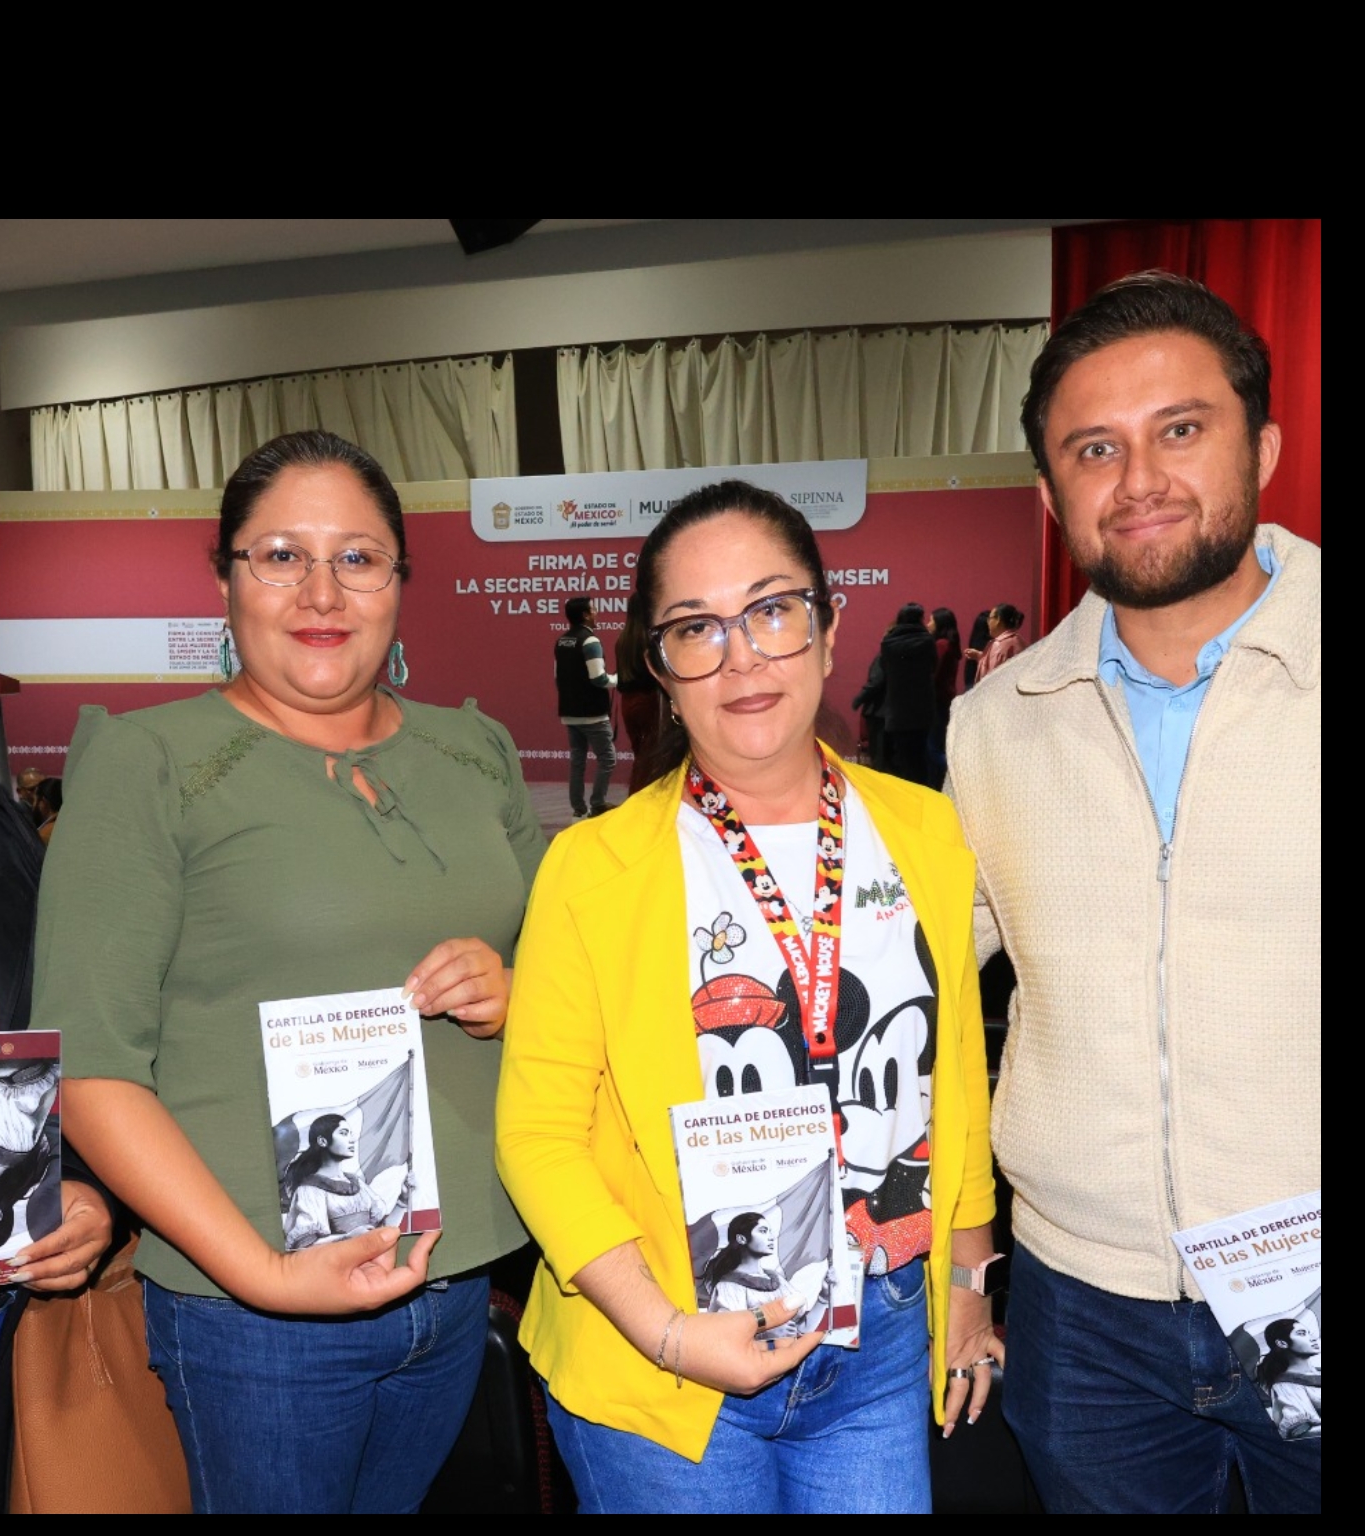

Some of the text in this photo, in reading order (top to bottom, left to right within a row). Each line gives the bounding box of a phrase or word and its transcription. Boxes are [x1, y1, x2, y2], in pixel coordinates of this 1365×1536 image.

[790, 492, 845, 505] SIPINNA
[574, 508, 617, 521] MÉXICO
[528, 554, 587, 571] FIRMA
[592, 553, 618, 569] DE
[456, 568, 889, 594] LA SECRETARÍA DE MSEM
[490, 598, 560, 615] Y LA SE
[781, 936, 810, 986] MICKEY
[812, 935, 835, 1033] MICKEY MOUSE
[266, 1004, 406, 1029] CARTILLA DE DERECHOS
[269, 1021, 408, 1049] de las Mujeres
[684, 1103, 826, 1129] CARTILLA DE DERECHOS
[686, 1120, 828, 1148] de las Mujeres
[1184, 1208, 1321, 1254] CARTILLA DE DERECHOS
[1193, 1227, 1321, 1271] de las Mujere
